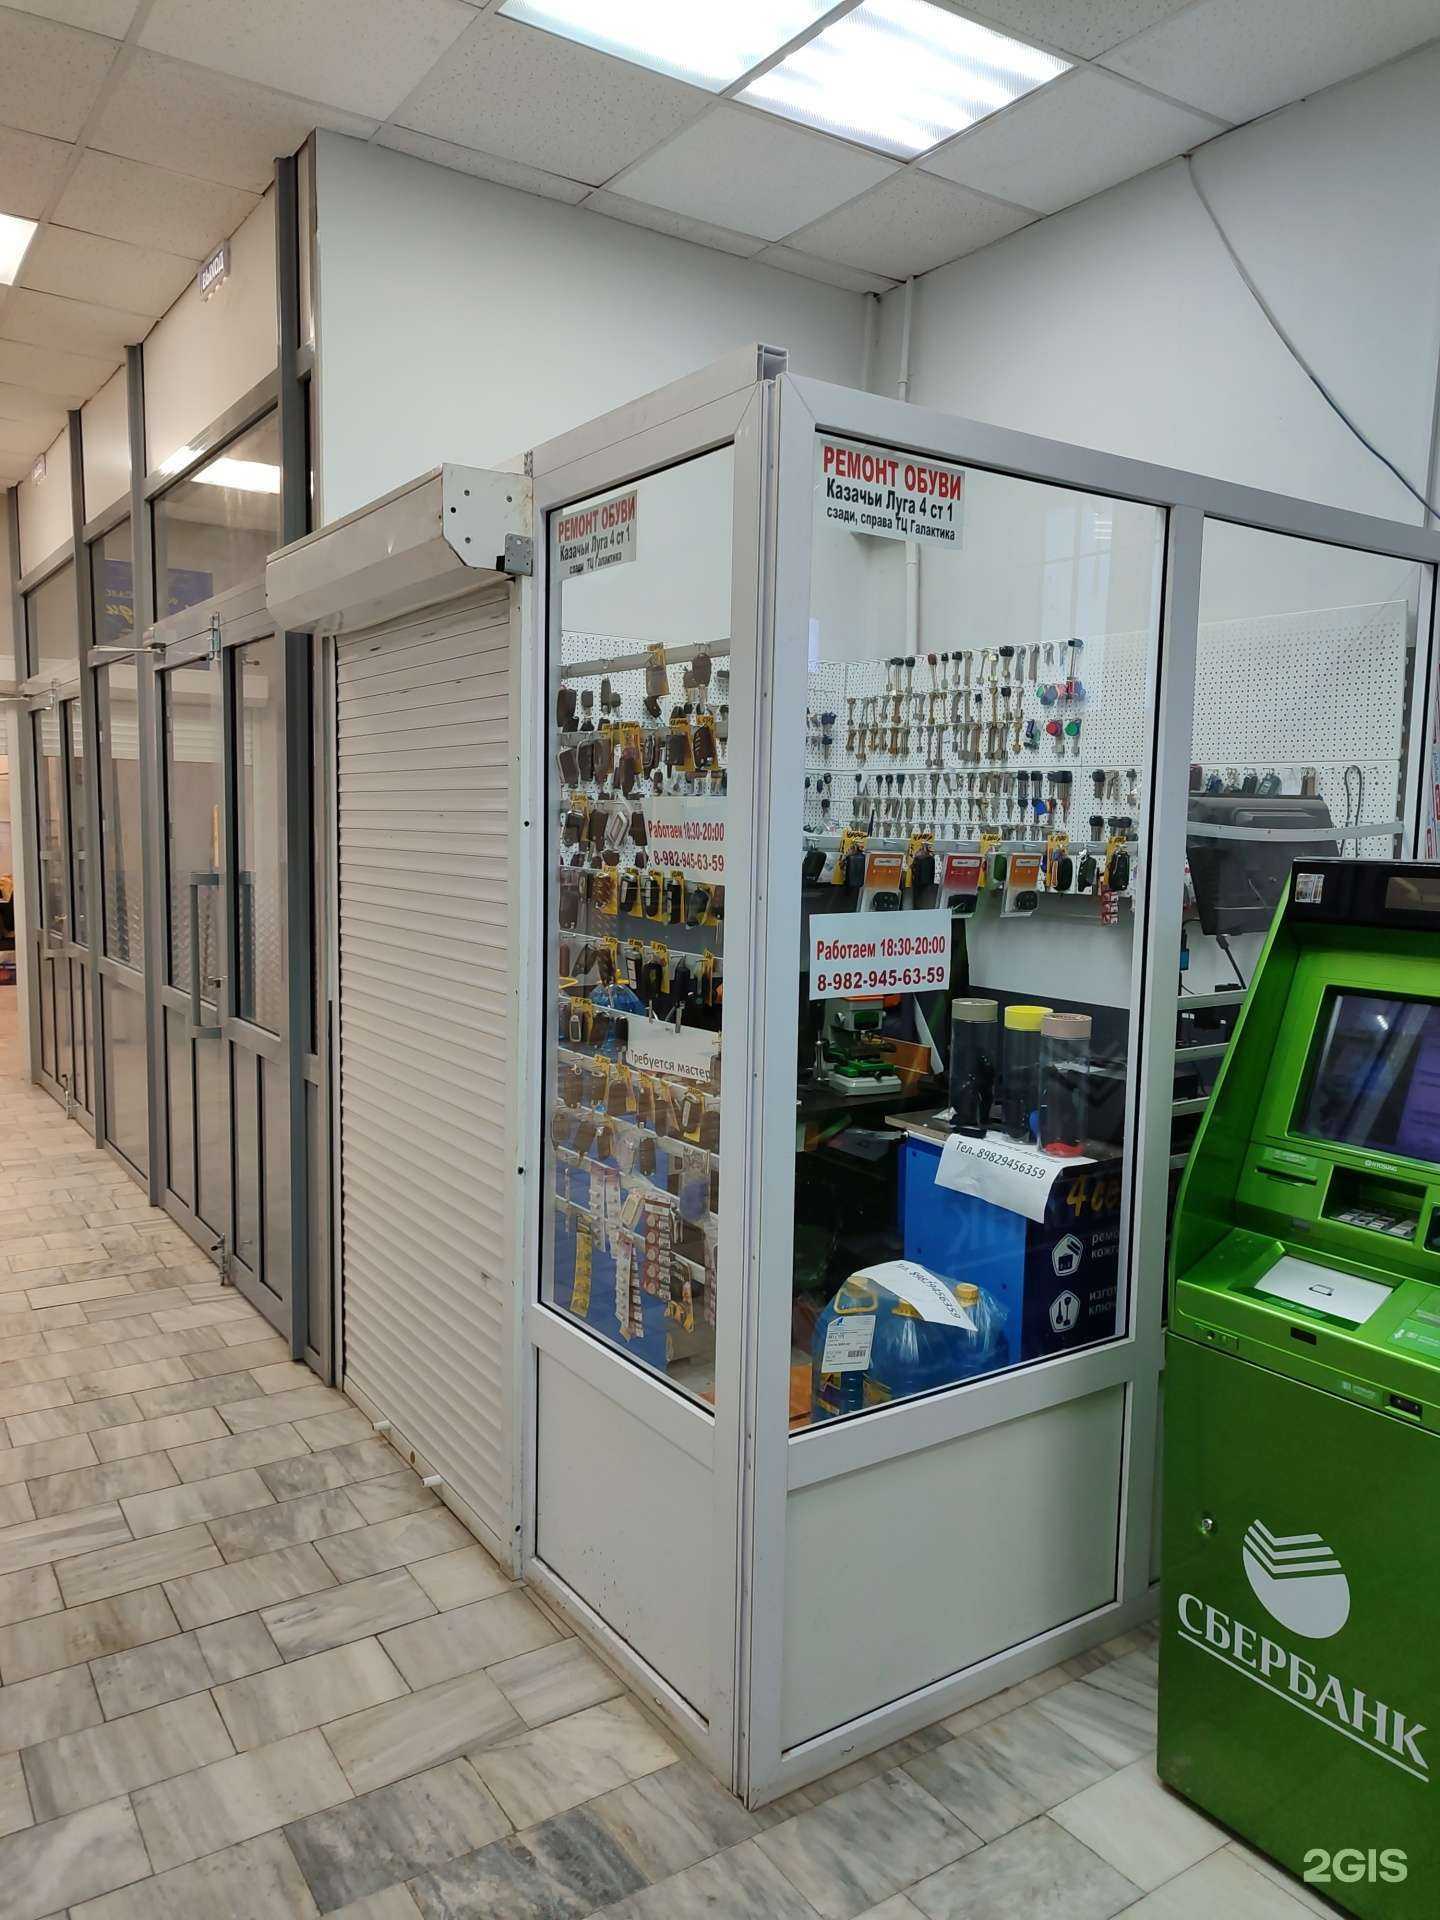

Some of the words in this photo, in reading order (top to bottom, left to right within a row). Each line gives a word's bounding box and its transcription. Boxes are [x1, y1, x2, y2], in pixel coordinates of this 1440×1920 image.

[202, 251, 224, 290] ВЫХОД
[824, 446, 899, 487] РЕМОНТ
[904, 464, 961, 501] ОБУВИ
[827, 477, 882, 508] Казачьи
[886, 490, 916, 517] Луга
[919, 497, 927, 516] 4
[930, 503, 943, 519] ст
[947, 503, 953, 522] 1
[558, 509, 600, 544] РЕМОНТ
[601, 496, 635, 530] ОБУВИ
[827, 506, 858, 526] сзади,
[861, 512, 892, 529] справа
[895, 516, 908, 534] ТЦ
[910, 519, 955, 541] Галактика
[560, 543, 590, 561] Казачьи
[590, 535, 608, 558] Луга
[610, 529, 615, 544] 4
[617, 531, 625, 545] ст
[626, 524, 630, 541] 1
[586, 558, 594, 571] ТЦ
[648, 820, 683, 838] Работаем
[653, 850, 725, 872] 8-982-945-63-59
[816, 939, 876, 960] Работаем
[880, 935, 946, 957] 18:30-20:00
[817, 966, 945, 991] 8-982-945-63-59
[630, 1049, 675, 1071] Требуется
[956, 1141, 975, 1156] Тел.
[976, 1148, 1046, 1179] 89829456359
[1178, 1593, 1429, 1770] СБЕРБАНК
